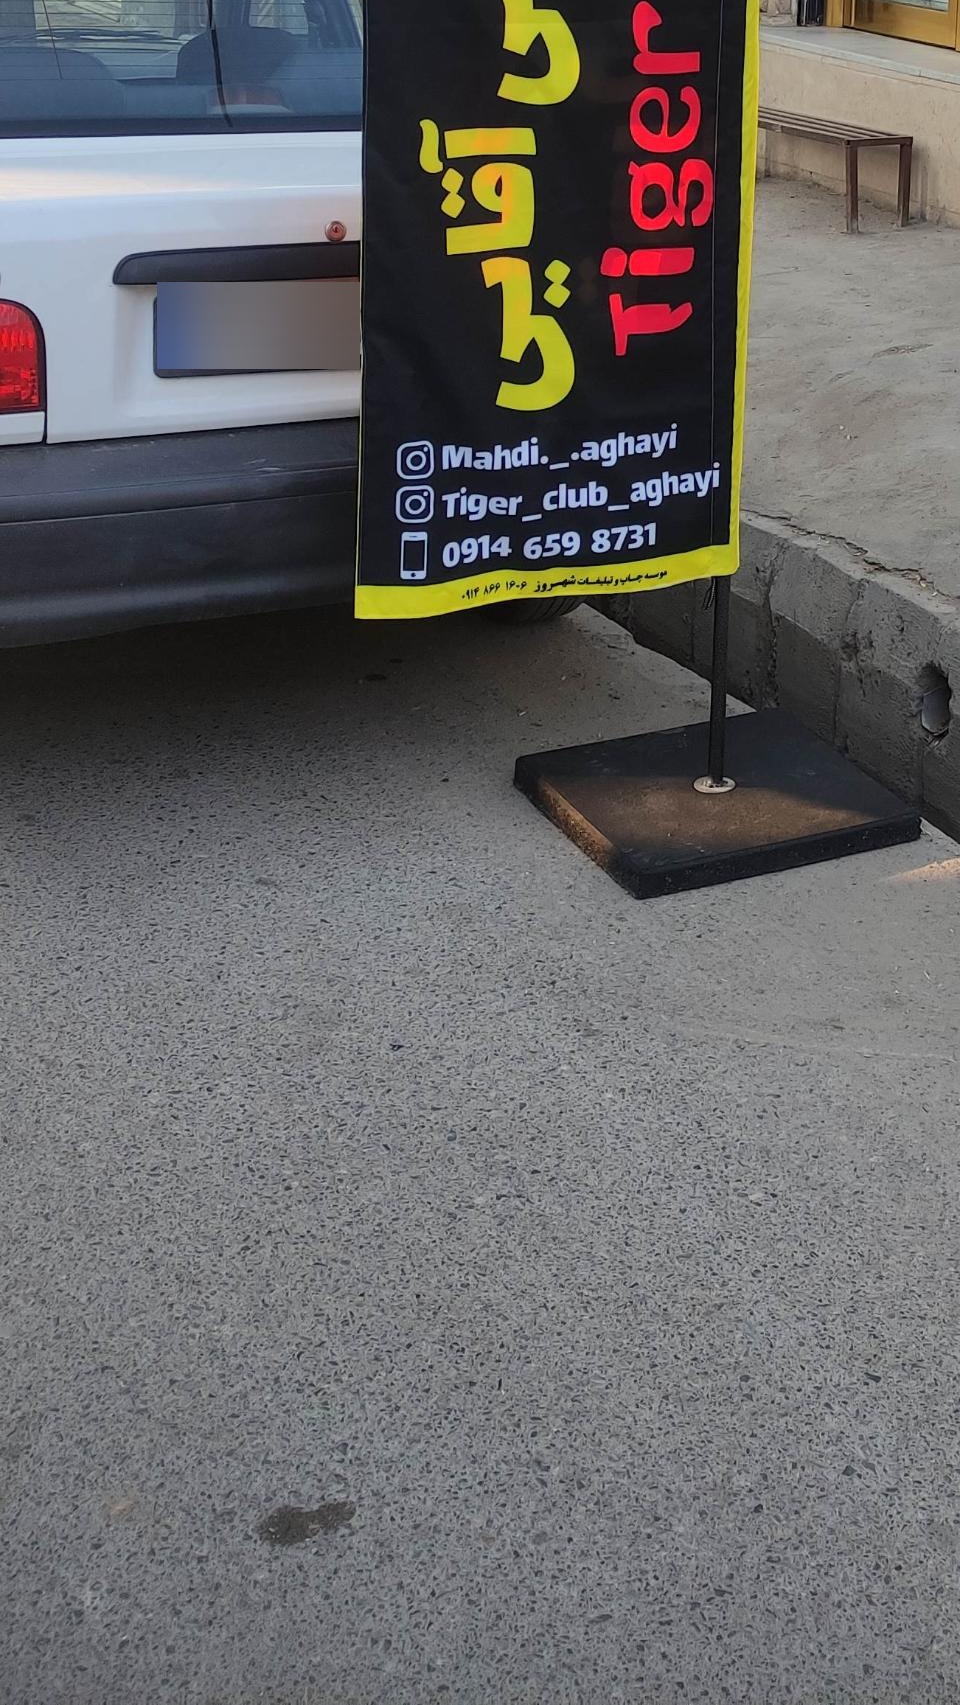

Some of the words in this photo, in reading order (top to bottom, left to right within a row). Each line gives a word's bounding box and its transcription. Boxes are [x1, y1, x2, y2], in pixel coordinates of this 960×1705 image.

[600, 0, 714, 357] Tiger
[419, 118, 576, 412] آقایی
[441, 423, 678, 472] Mahdi._.aghayi
[441, 462, 721, 523] Tiger_club_aghayi
[442, 534, 512, 568] 0914
[523, 531, 581, 560] 659
[590, 522, 658, 553] 8731
[614, 578, 619, 586] و
